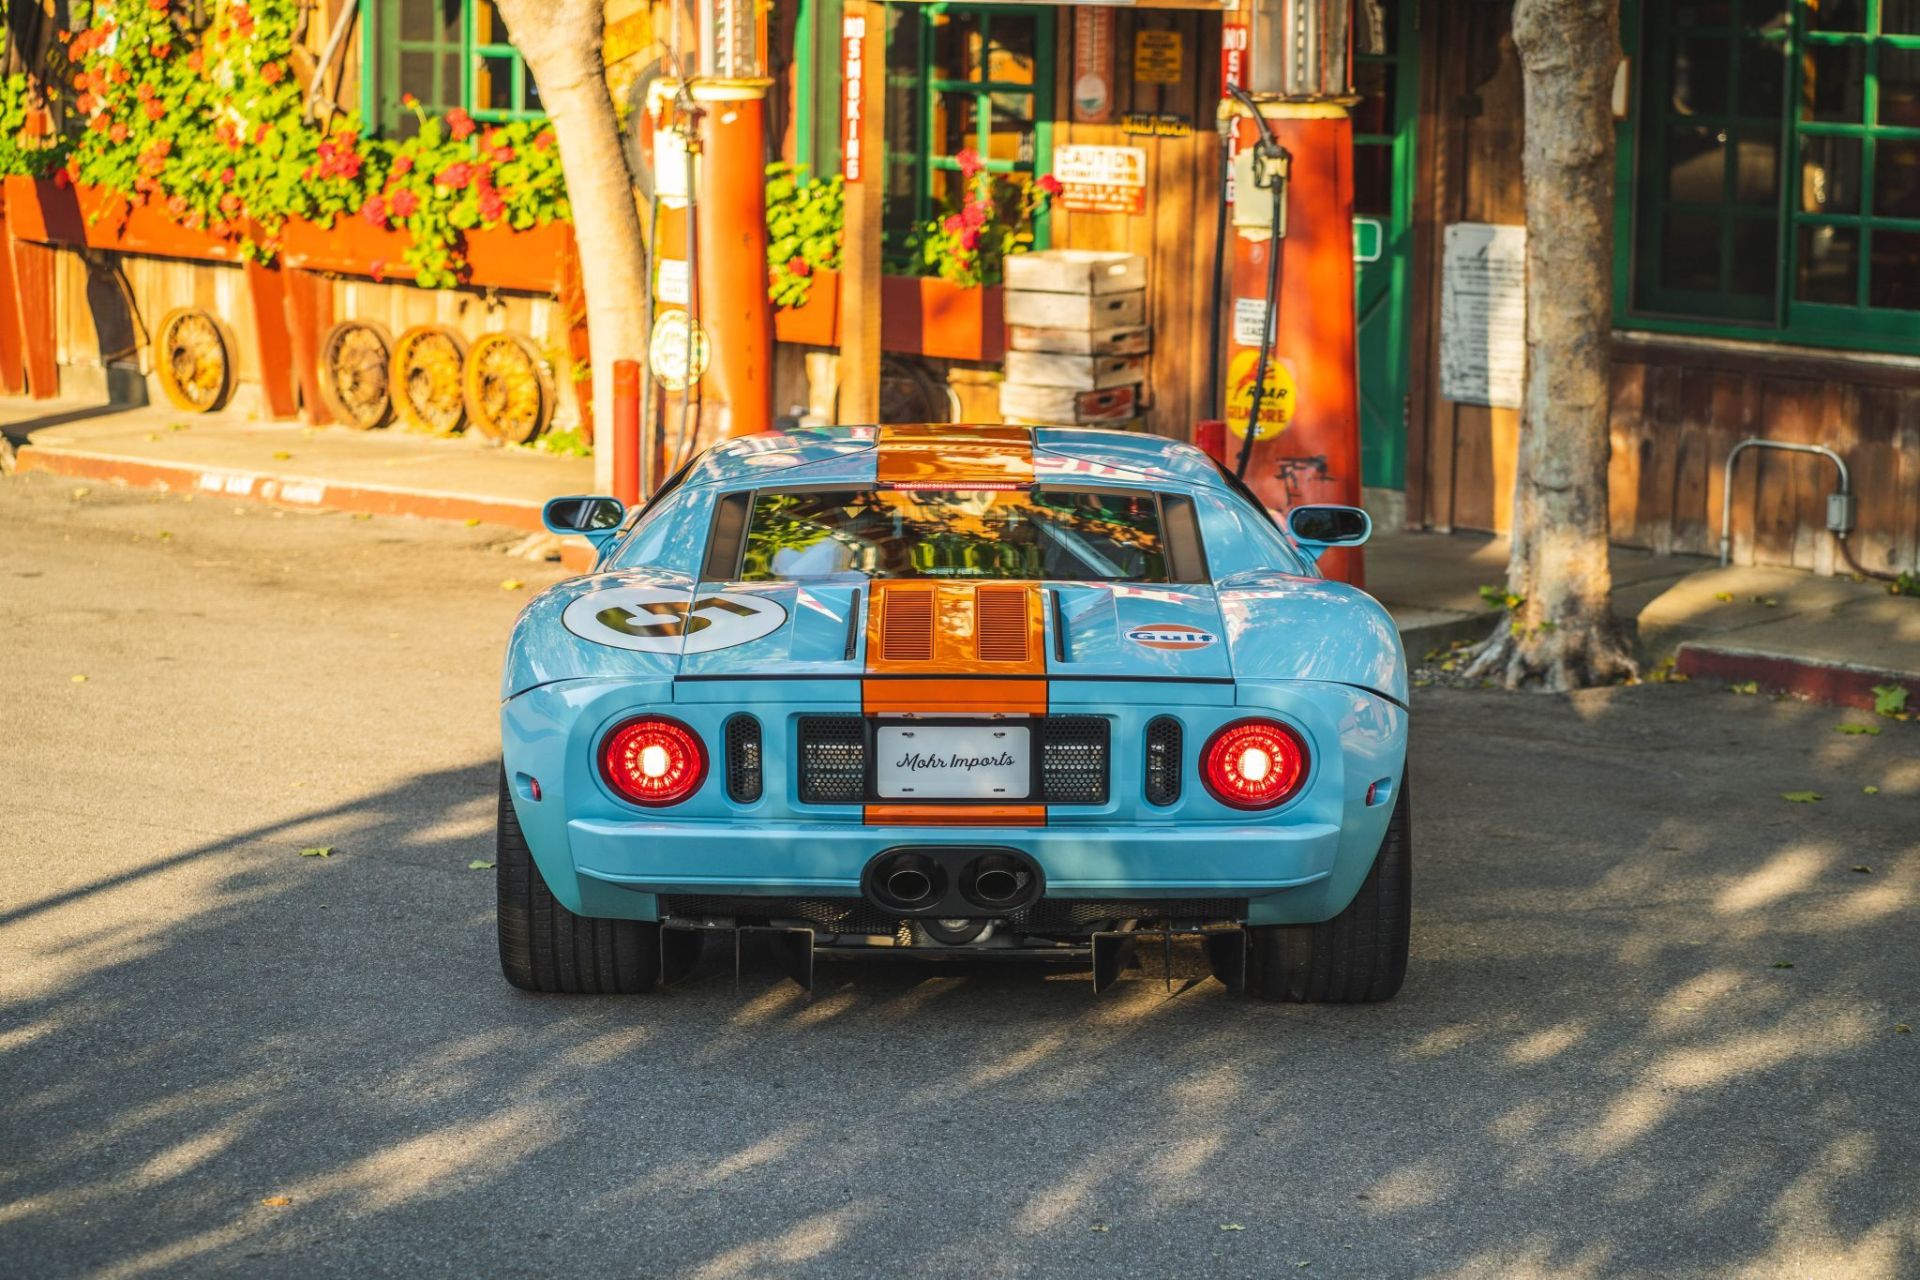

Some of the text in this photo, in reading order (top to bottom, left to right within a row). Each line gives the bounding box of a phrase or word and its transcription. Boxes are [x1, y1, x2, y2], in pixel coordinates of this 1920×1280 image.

[844, 17, 865, 179] NO SMOKING
[1223, 28, 1247, 202] NO SMKING
[1061, 148, 1138, 168] CAUTION
[596, 597, 761, 638] 5
[1129, 631, 1213, 642] Gulf
[896, 751, 1015, 771] Mohr Imports
